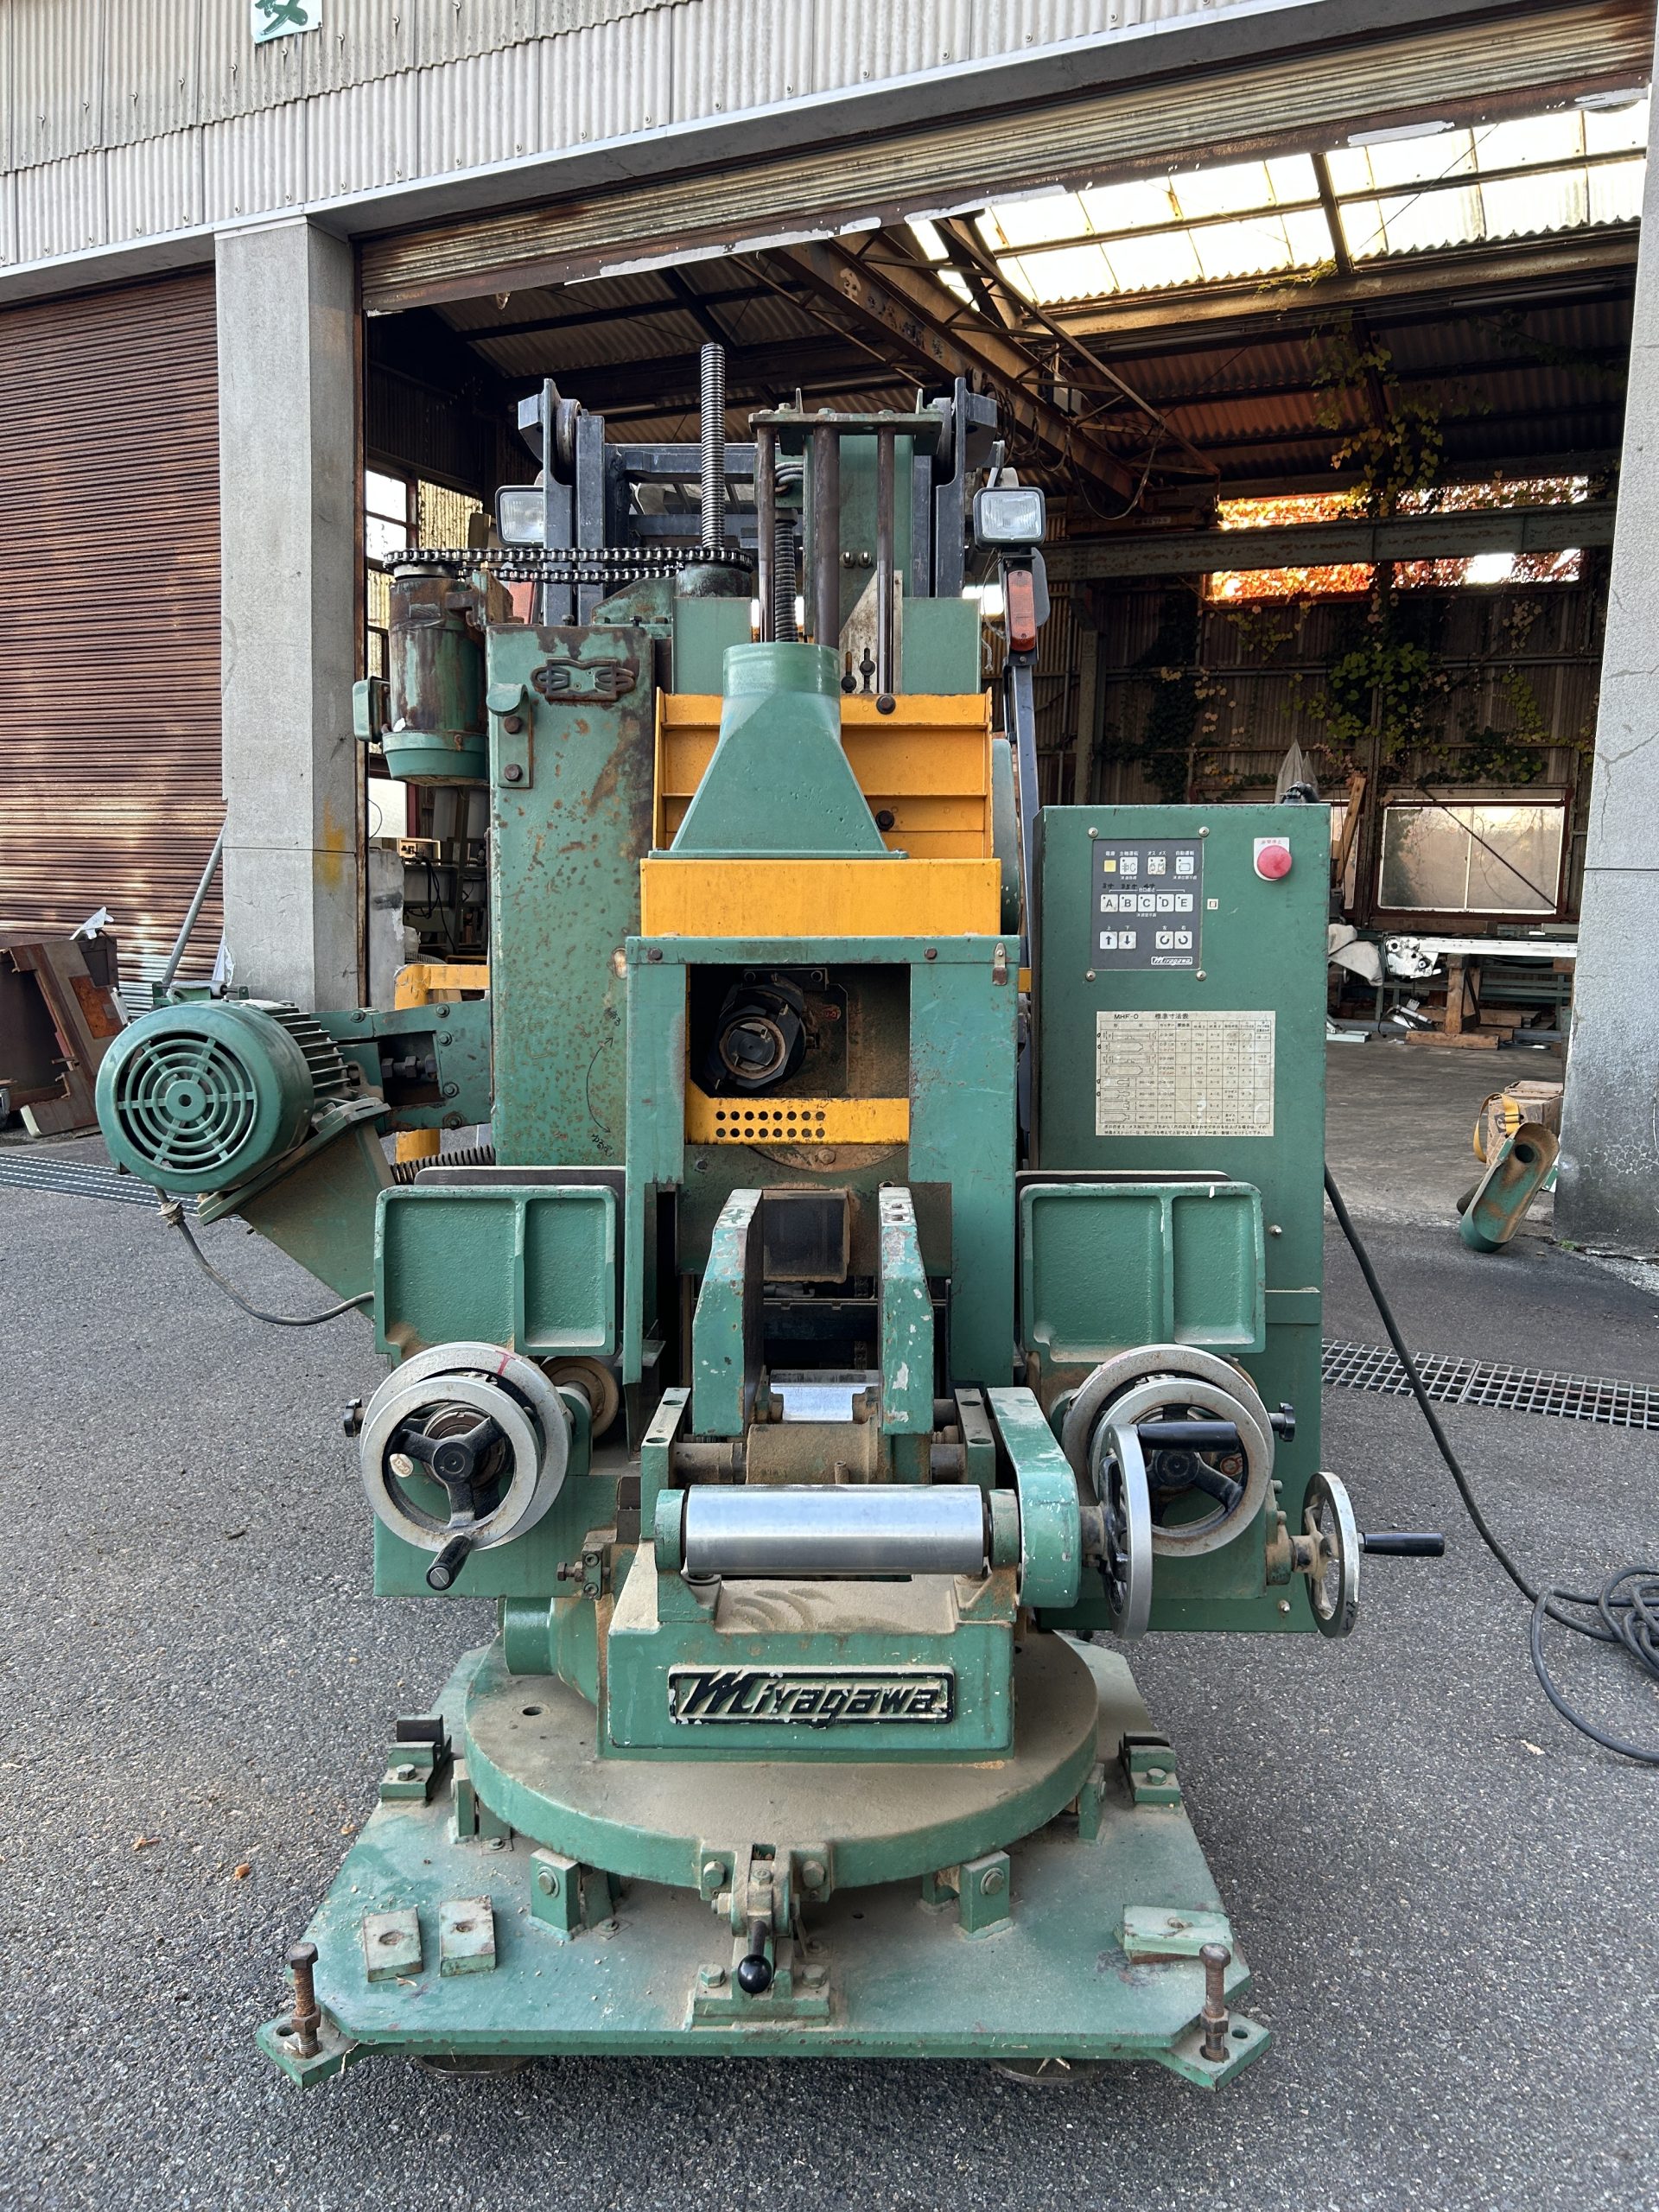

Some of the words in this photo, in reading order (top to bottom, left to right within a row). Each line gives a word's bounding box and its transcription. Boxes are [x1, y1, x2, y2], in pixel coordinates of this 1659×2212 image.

[1105, 899, 1113, 907] A
[1124, 899, 1132, 907] B
[1142, 899, 1151, 907] C
[1161, 899, 1169, 907] D
[1180, 899, 1187, 907] E
[680, 1669, 944, 1728] Miyagawa
